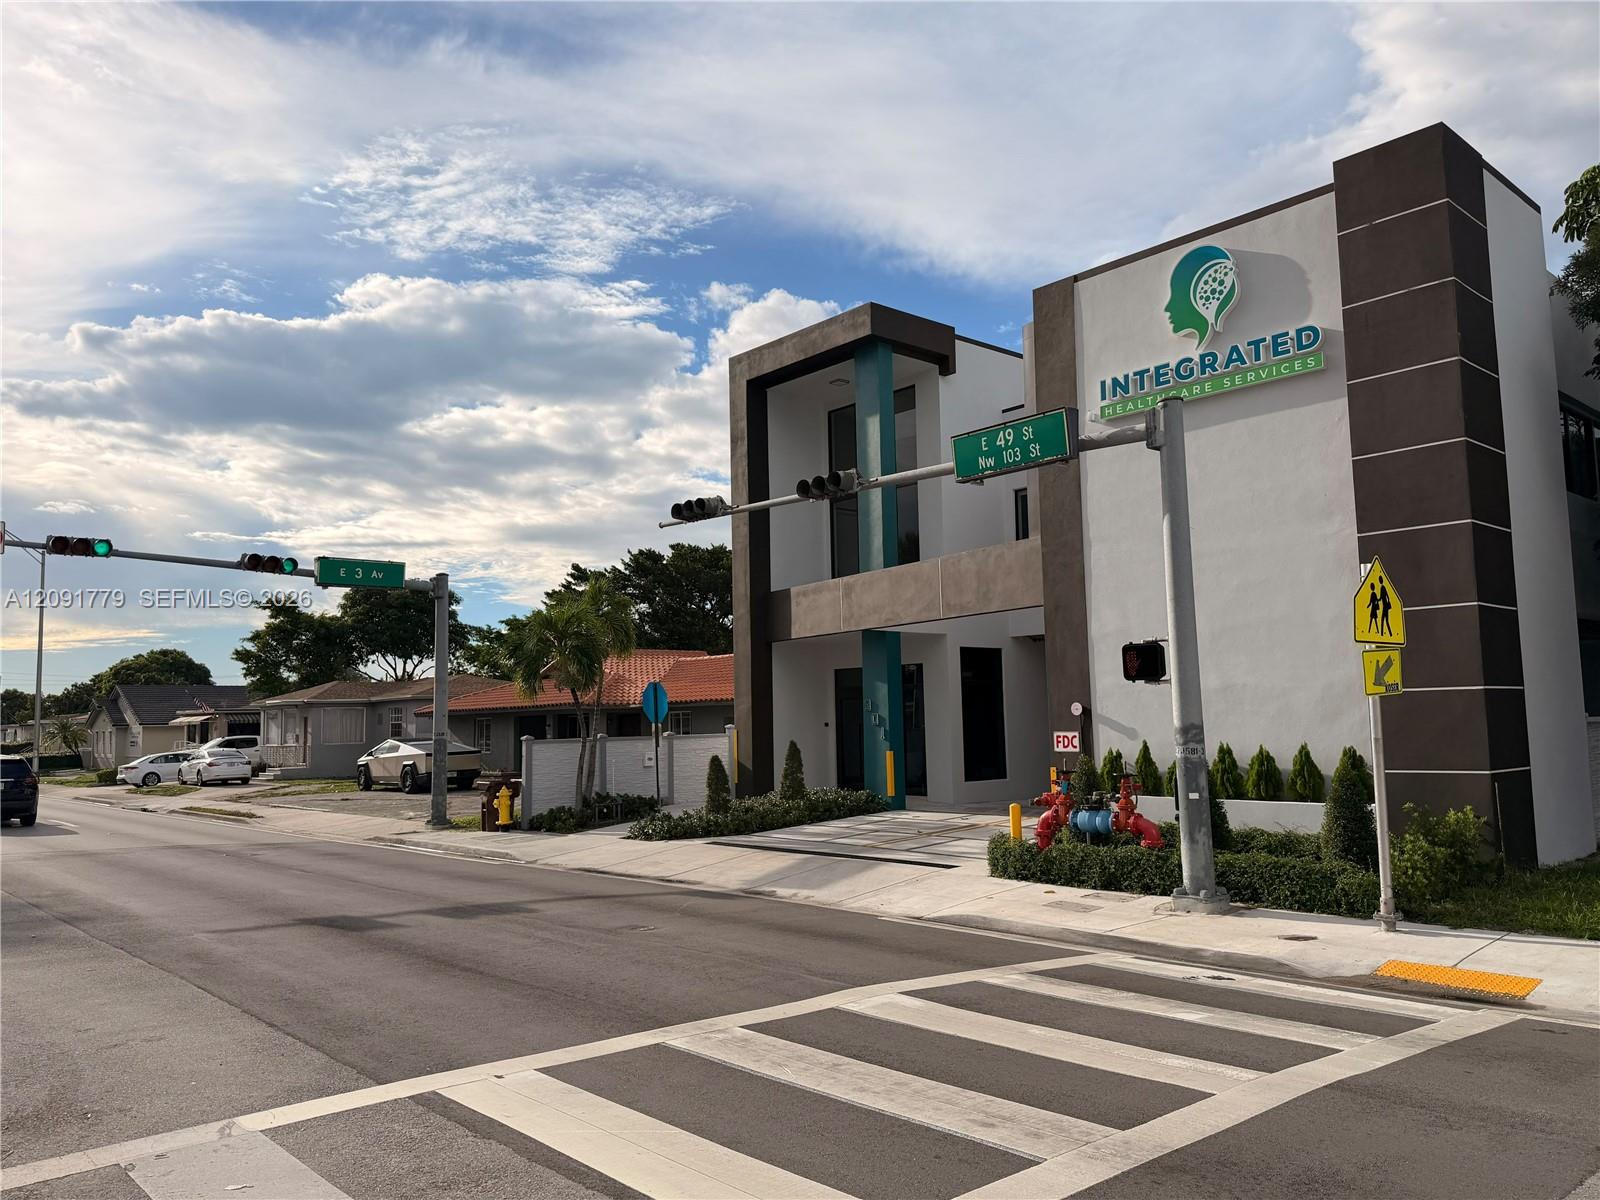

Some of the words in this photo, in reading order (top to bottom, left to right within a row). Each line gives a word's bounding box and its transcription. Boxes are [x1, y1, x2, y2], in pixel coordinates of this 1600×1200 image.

[1100, 325, 1322, 401] INTEGRATED
[1223, 357, 1316, 388] SERVICES
[981, 437, 989, 451] E
[996, 428, 1014, 448] 49
[1022, 425, 1034, 440] St
[978, 455, 995, 470] Nw
[1002, 447, 1021, 464] 103
[1029, 442, 1041, 458] St
[340, 568, 346, 576] E
[355, 568, 363, 578] 3
[370, 570, 384, 578] Av
[1056, 735, 1078, 749] FDC
